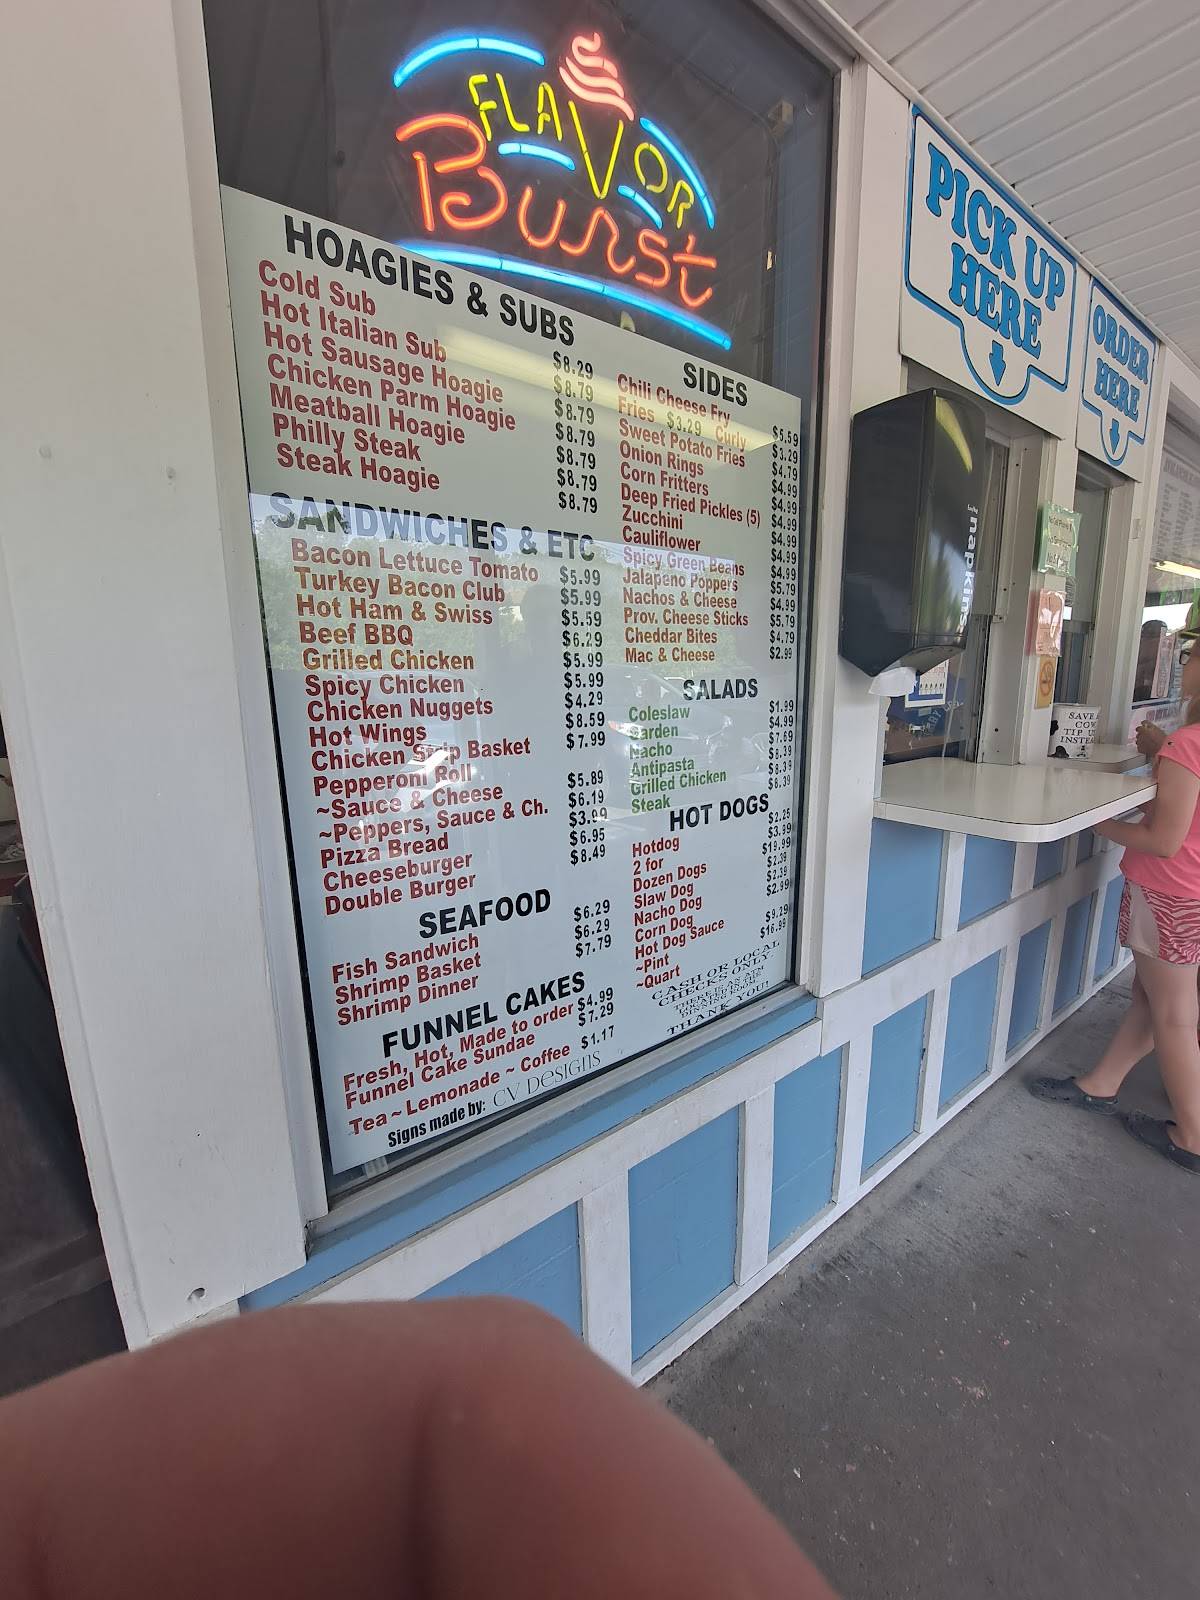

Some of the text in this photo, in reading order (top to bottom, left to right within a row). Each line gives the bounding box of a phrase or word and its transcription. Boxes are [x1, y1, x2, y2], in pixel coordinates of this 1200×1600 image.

[468, 73, 695, 229] FLAVOR
[395, 114, 717, 307] Burst
[926, 142, 1065, 311] PICK UP
[258, 260, 376, 315] Cold Sub
[284, 214, 574, 346] HOAGIES & SUBS
[949, 243, 1041, 360] HERE
[261, 290, 446, 363] Hot Italian Sub
[1093, 305, 1150, 384] ORDER
[263, 322, 503, 403] Hot Sausage Hoagie
[553, 351, 593, 379] $8.29
[267, 354, 516, 432] Chicken Parm Hoagie
[618, 374, 730, 427] Chili Cheese Fry
[683, 362, 747, 406] SIDES
[1095, 358, 1140, 422] HERE
[270, 382, 465, 446] Meatball Hoagie
[554, 399, 594, 424] $8.79
[618, 396, 746, 451] Fries $3.29 Curly
[273, 413, 421, 462] Philly Steak
[619, 418, 745, 467] Sweet Potato Fries
[772, 426, 798, 446] $5.59
[277, 443, 440, 492] Steak Hoagie
[620, 440, 703, 478] Onion Rings
[772, 462, 797, 480] $4.79
[621, 462, 709, 496] Corn Fritters
[621, 483, 743, 522] Deep Fried Pickles
[622, 504, 683, 529] Zucchini
[269, 492, 594, 561] SANDWICHES & ETC
[623, 525, 700, 551] Cauliflower
[291, 538, 539, 582] Bacon Lettuce Tomato
[559, 566, 600, 585] $5.99
[624, 546, 744, 576] Spicy Green Beans
[959, 516, 979, 627] napkins
[294, 567, 505, 602] Turkey Bacon Club
[623, 587, 737, 608] Nachos Cheese
[691, 574, 738, 593] Poppers
[297, 594, 492, 625] Hot Ham Swiss
[624, 607, 748, 625] Prov. Cheese Sticks
[299, 621, 414, 647] Beef BBQ
[625, 627, 717, 644] Cheddar Bites
[303, 648, 474, 670] Grilled Chicken
[625, 647, 715, 662] Mac Cheese
[305, 674, 465, 700] Spicy Chicken
[683, 679, 758, 700] SALADS
[307, 698, 493, 722] Chicken Nuggets
[629, 705, 690, 722] Coleslaw
[309, 725, 426, 747] Hot Wings
[312, 737, 530, 772] Chicken Basket
[631, 758, 695, 779] Antipasta
[434, 764, 472, 784] Roll
[631, 770, 726, 795] Grilled Chicken
[432, 787, 503, 807] Cheese
[437, 799, 548, 829] Sauce Ch.
[631, 795, 670, 813] Steak
[670, 793, 768, 832] HOT DOGS
[321, 833, 449, 869] Pizza Bread
[632, 837, 680, 858] Hotdog
[323, 853, 472, 892] Cheeseburger
[633, 864, 707, 892] Dozen Dogs
[326, 873, 476, 916] Double Burger
[574, 900, 610, 921] $6.29
[634, 883, 693, 909] Slaw Dog
[634, 896, 701, 926] Nacho Dog
[419, 888, 550, 939] SEAFOOD
[635, 915, 693, 943] Corn Dog
[635, 919, 724, 959] Hot Dog Sauce
[333, 933, 479, 983] Fish Sandwich
[652, 974, 701, 1000] CASH
[707, 963, 728, 977] OR
[734, 940, 780, 966] LOCAL
[335, 954, 481, 1004] Shrimp Basket
[658, 973, 727, 1007] CHECKS
[337, 975, 478, 1026] Shrimp Dinner
[383, 972, 585, 1058] FUNNEL CAKES
[578, 1002, 614, 1027] $7.29
[667, 1004, 729, 1035] THANK
[737, 981, 769, 1002] YOU!
[344, 1002, 573, 1091] Fresh, Hot, Made to order
[346, 1033, 535, 1109] Funnel Cake Sundae
[407, 1045, 570, 1116] Lemonade Coffee
[388, 1101, 486, 1148] Signs made by:
